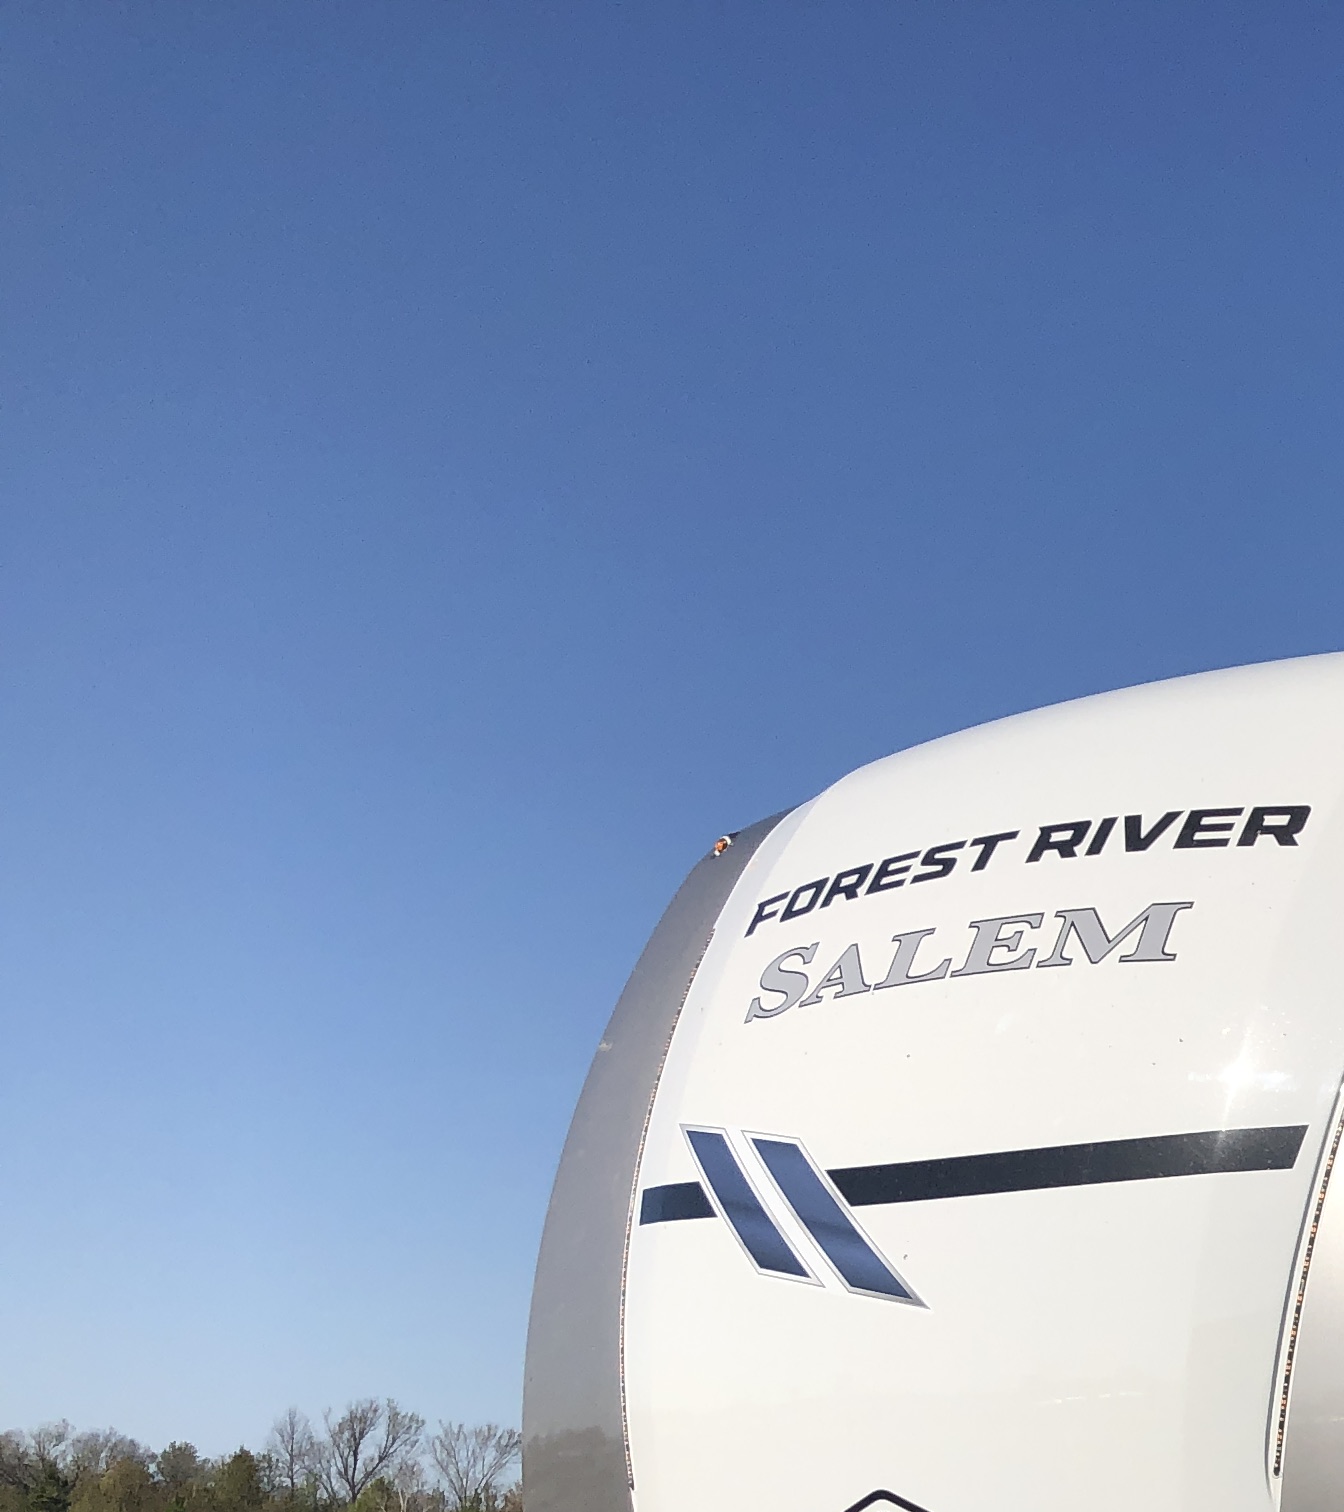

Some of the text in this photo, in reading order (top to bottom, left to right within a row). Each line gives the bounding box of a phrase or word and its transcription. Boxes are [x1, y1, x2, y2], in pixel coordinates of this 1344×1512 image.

[744, 804, 1312, 937] FOREST RIVER
[743, 901, 1195, 1024] SALEM
